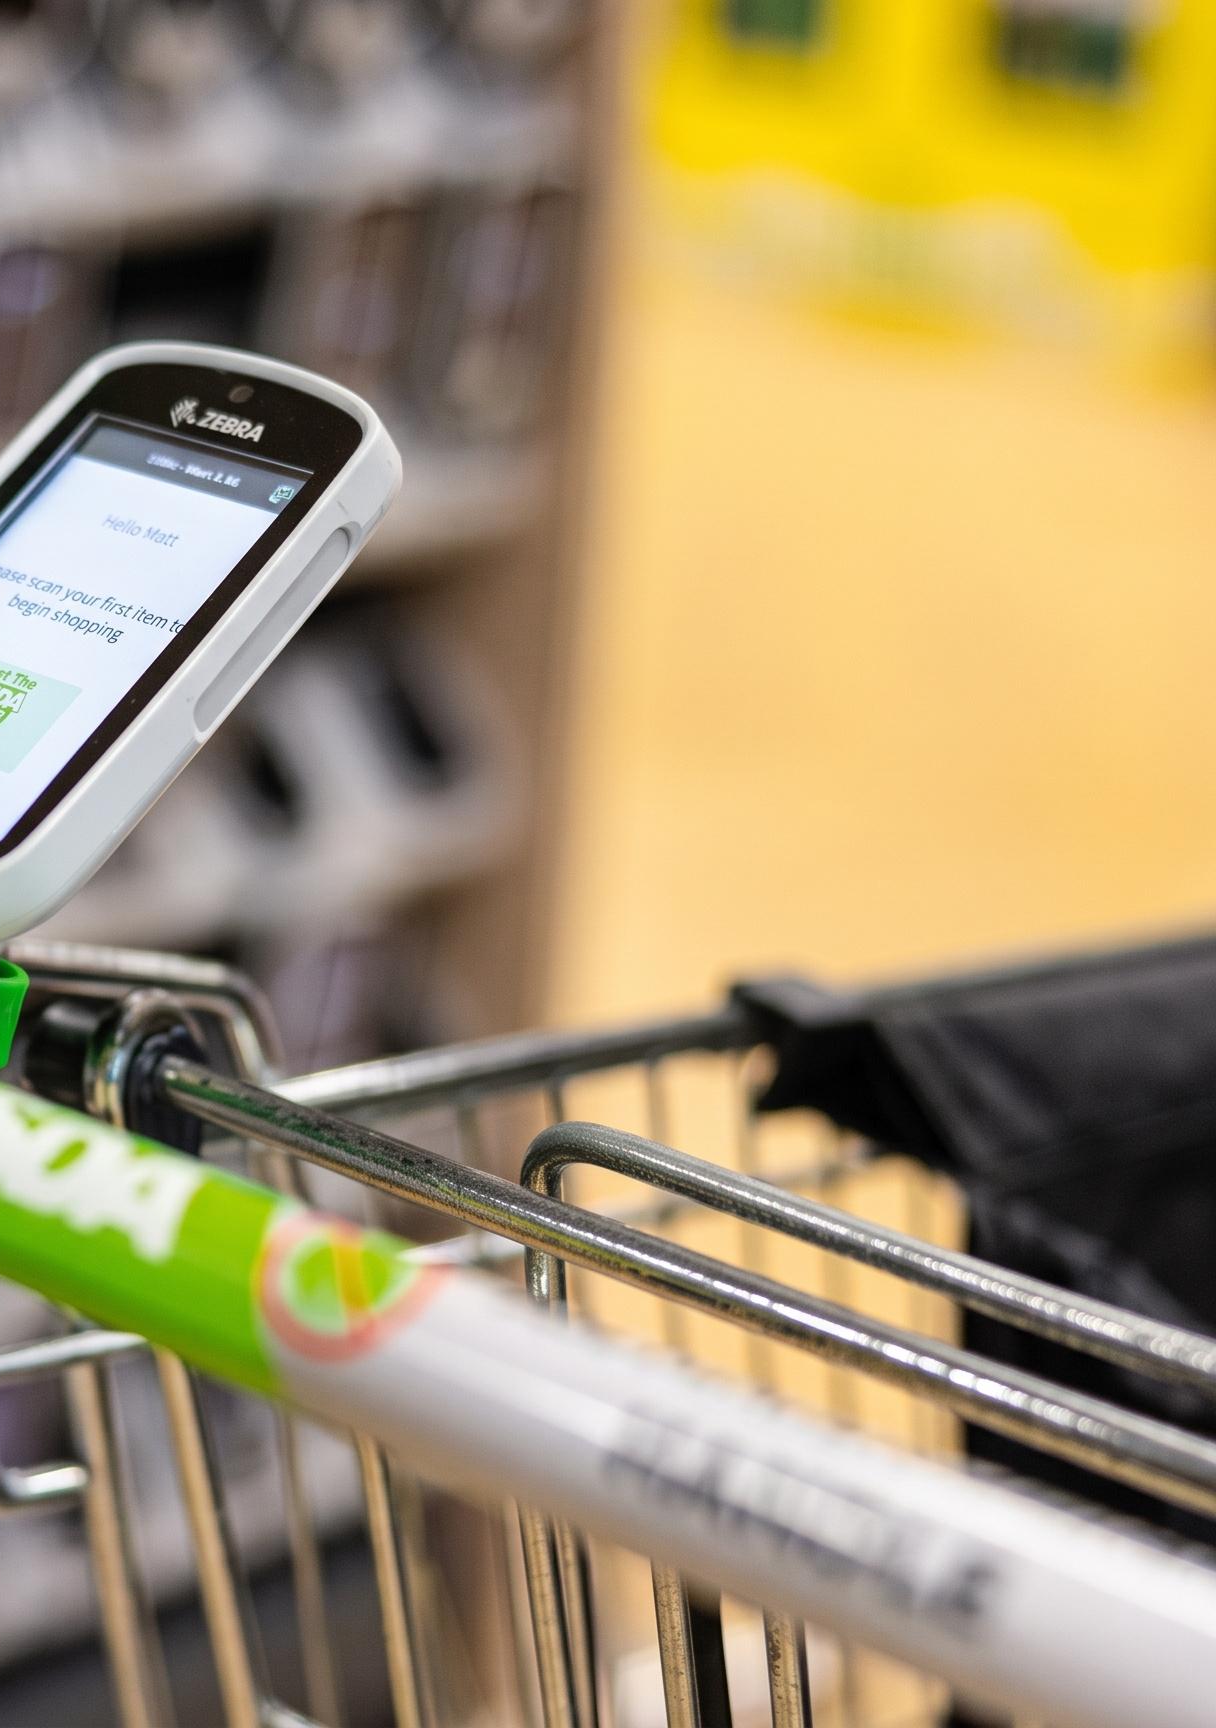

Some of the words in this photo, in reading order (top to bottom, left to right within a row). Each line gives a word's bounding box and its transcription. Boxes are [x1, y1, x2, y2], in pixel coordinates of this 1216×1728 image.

[197, 411, 265, 443] ZEBRA
[102, 514, 142, 537] Hello
[143, 527, 180, 548] Matt
[8, 593, 51, 617] begin
[50, 610, 124, 644] shopping
[27, 577, 63, 596] scan
[62, 587, 104, 607] your
[99, 596, 134, 618] first
[132, 606, 168, 630] item
[15, 672, 37, 690] The
